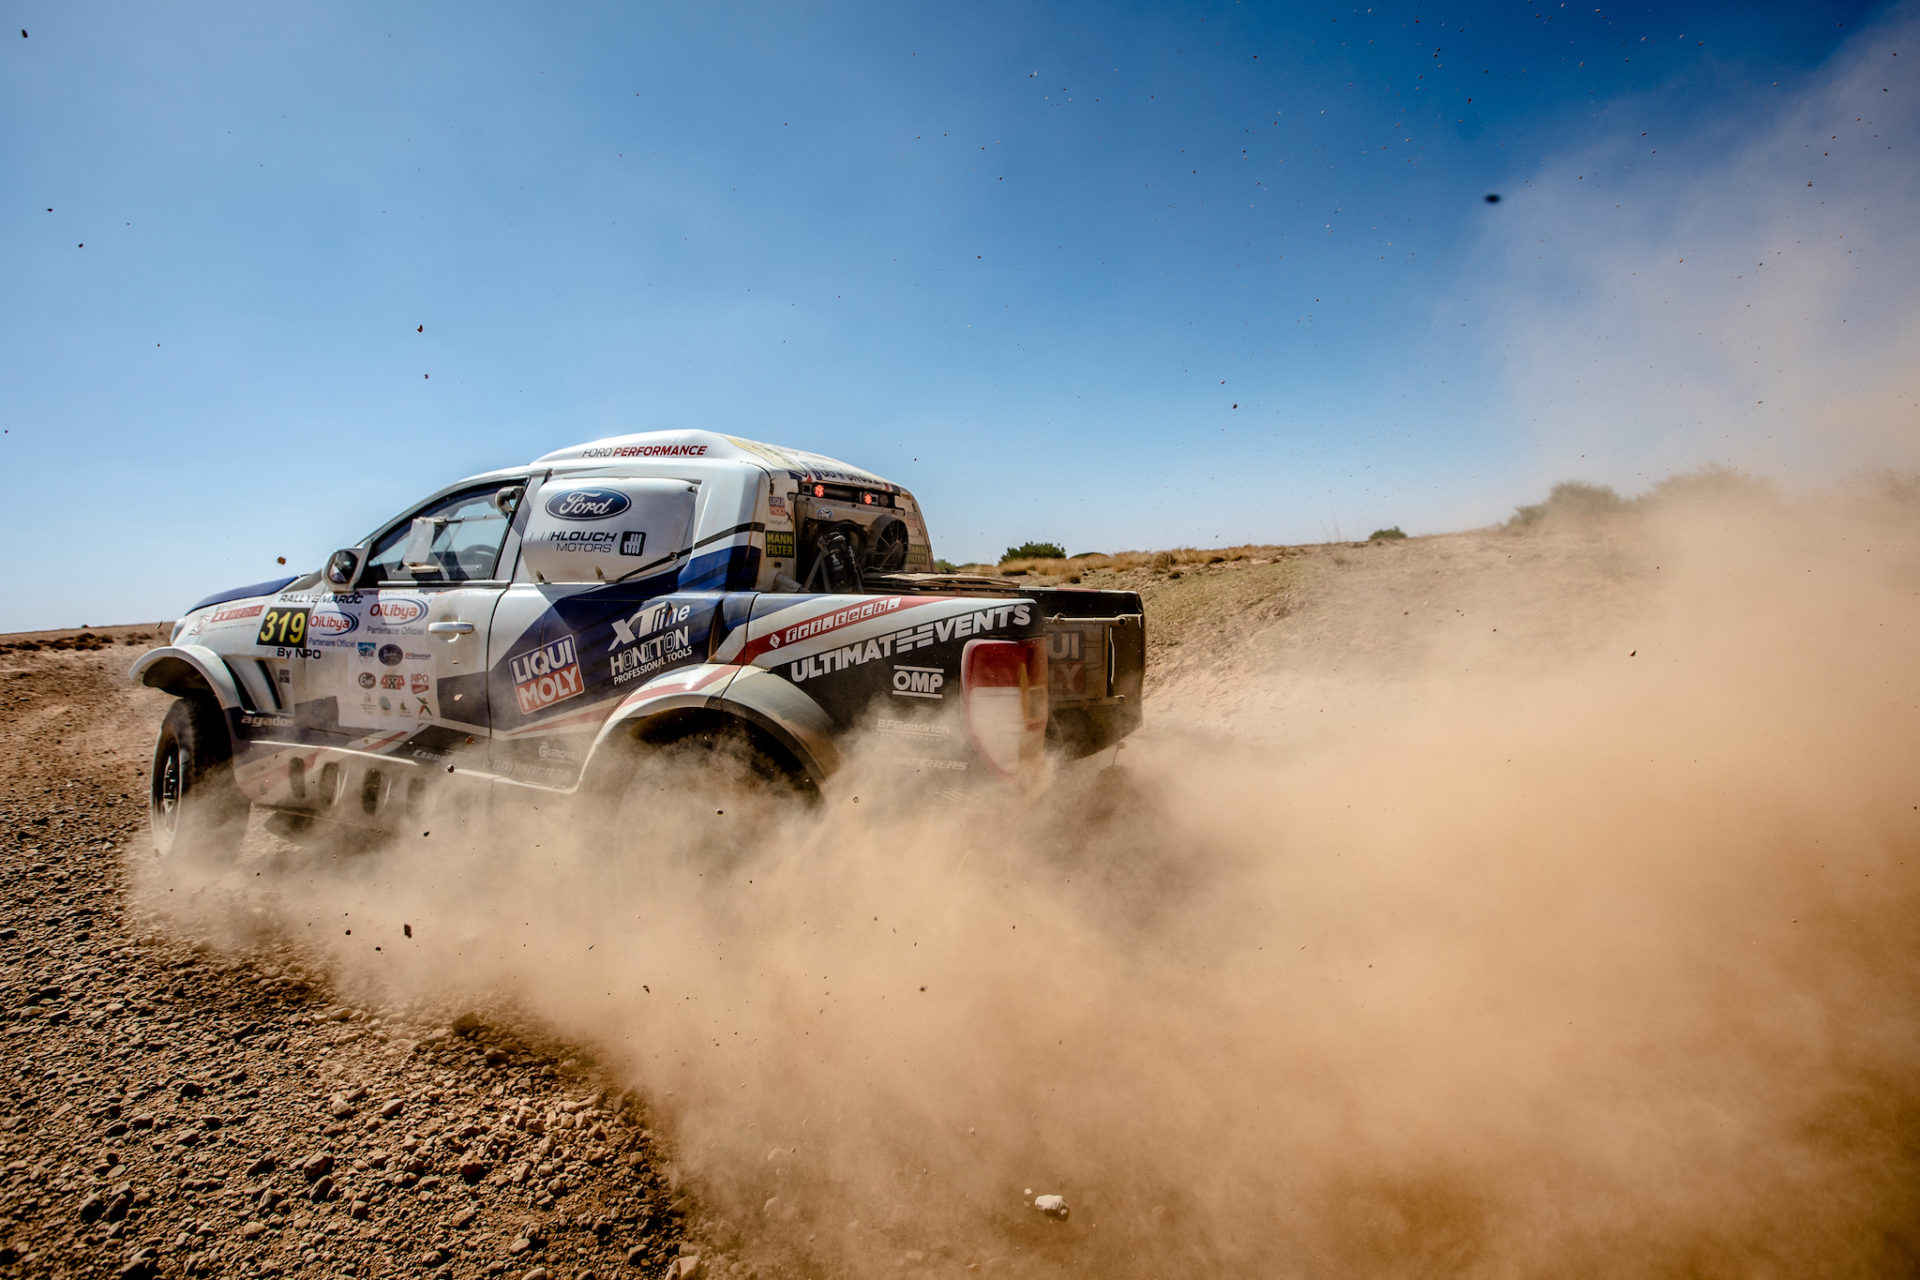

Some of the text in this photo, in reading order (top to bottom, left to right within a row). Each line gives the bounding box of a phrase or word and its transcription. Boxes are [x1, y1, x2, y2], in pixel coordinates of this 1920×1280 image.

[582, 445, 708, 458] FORD PERFORMANCE
[558, 491, 614, 515] Ford
[550, 531, 618, 542] HLOUCH
[766, 533, 793, 545] MANN
[556, 542, 613, 553] MOTORS
[767, 545, 793, 556] FILTER
[259, 610, 306, 644] 319
[277, 647, 321, 660] By NPO
[609, 625, 690, 677] HONITON
[511, 639, 574, 684] LIQUI
[613, 646, 693, 686] PROFESSIONAL TOOLS
[517, 665, 579, 711] MOLY
[892, 670, 944, 693] OMP
[876, 719, 950, 734] BFGoodrich
